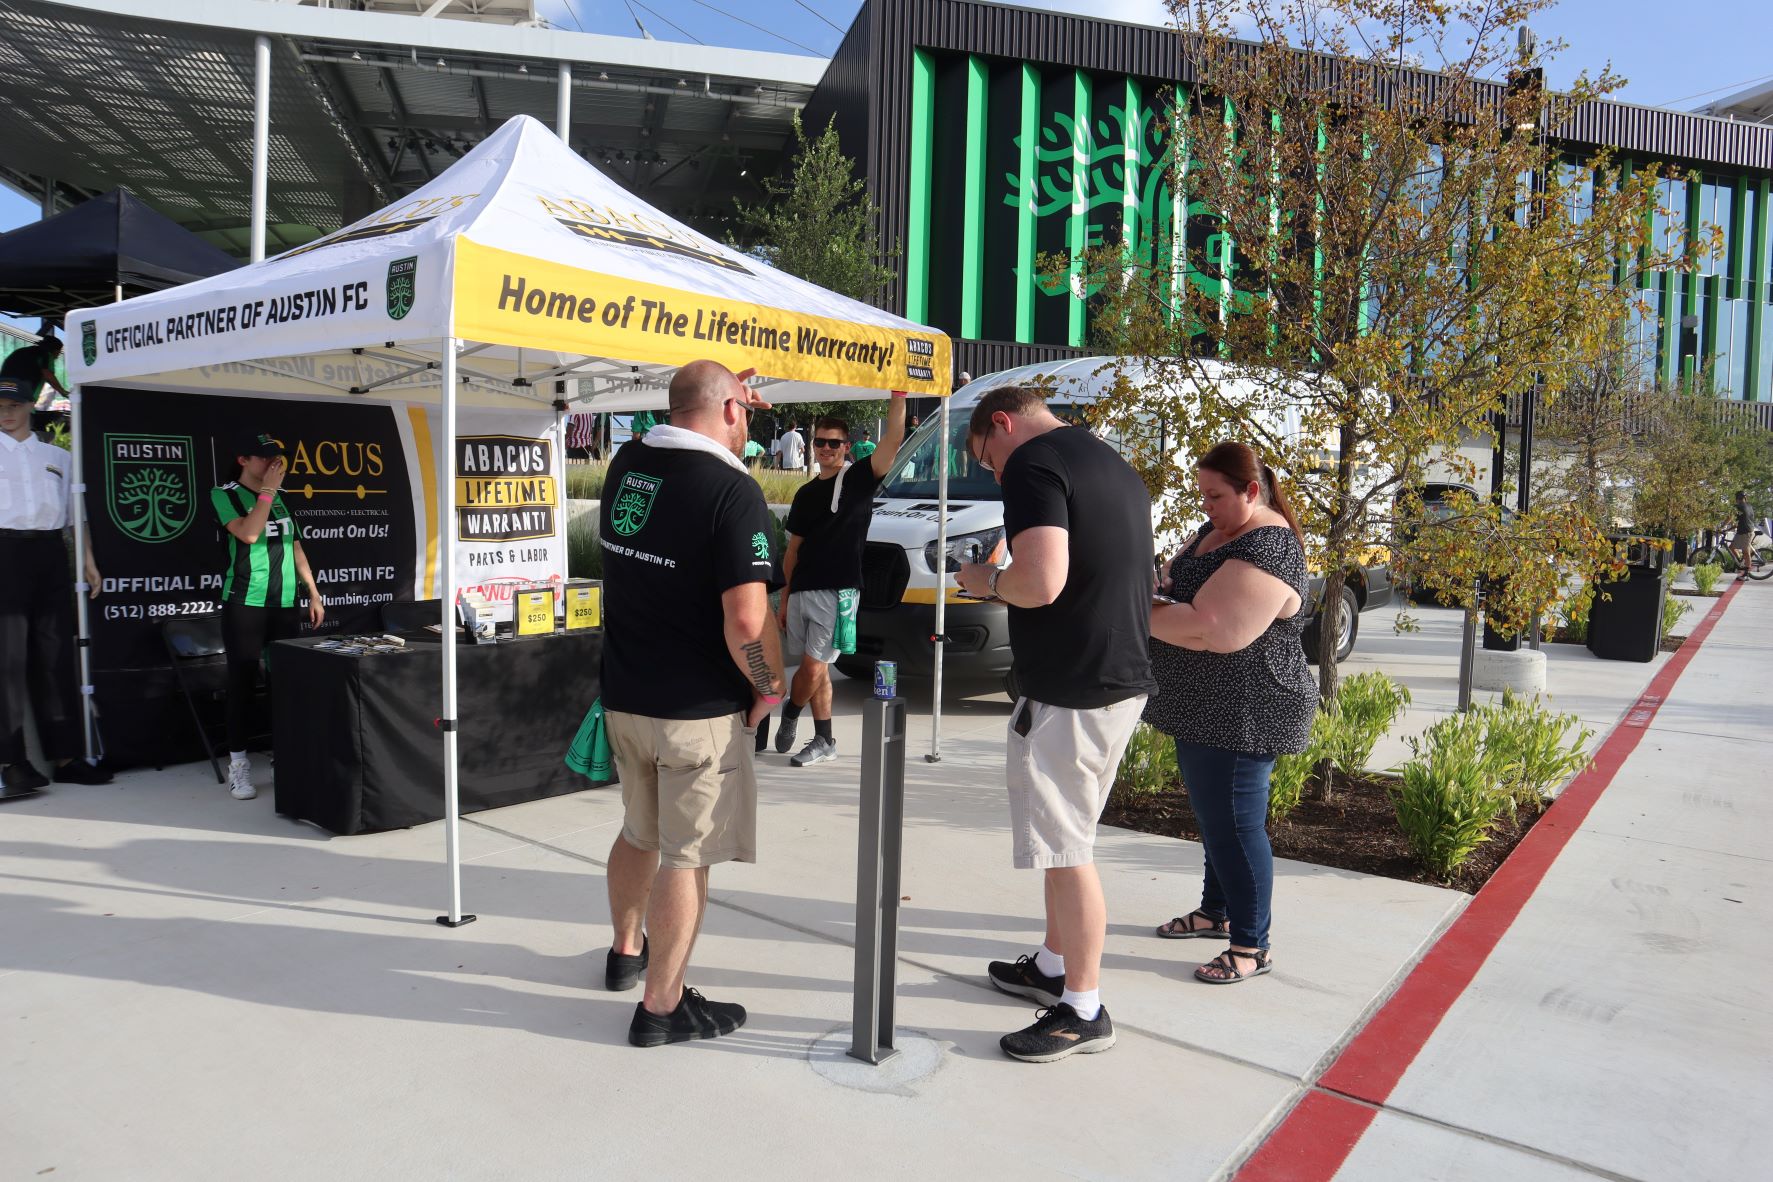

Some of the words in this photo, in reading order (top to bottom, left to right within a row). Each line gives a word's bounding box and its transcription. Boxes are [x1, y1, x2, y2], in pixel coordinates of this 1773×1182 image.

[537, 195, 724, 256] ABACUS
[391, 261, 414, 274] AUSTIN
[105, 320, 163, 353] OFFICIAL
[167, 305, 237, 342] PARTNER
[241, 301, 264, 329] OF
[265, 287, 336, 326] AUSTIN
[342, 281, 368, 313] FC
[498, 274, 596, 323] Home
[601, 296, 636, 329] of
[641, 299, 689, 337] The
[693, 308, 791, 352] Lifetime
[796, 325, 895, 373] Warranty!
[909, 340, 932, 355] ABACUS
[117, 444, 182, 459] AUSTIN
[464, 444, 544, 473] ABACUS
[465, 480, 546, 504] LIFETIME
[626, 476, 656, 492] AUSTIN
[294, 509, 346, 517] CONDITIONING
[467, 511, 546, 534] WARRANTY
[303, 525, 345, 539] Count
[347, 524, 366, 538] On
[369, 524, 389, 538] Us!
[469, 550, 504, 567] PARTS
[508, 549, 515, 563] &
[520, 548, 548, 563] LABOR
[624, 548, 634, 557] OF
[635, 550, 662, 565] AUSTIN
[664, 558, 676, 568] FC
[102, 576, 195, 593] OFFICIAL
[316, 567, 372, 584] AUSTIN
[376, 566, 395, 580] FC
[104, 604, 144, 620] (512)
[148, 601, 214, 617] 888-2222
[527, 613, 546, 623] $250
[574, 608, 593, 617] $250
